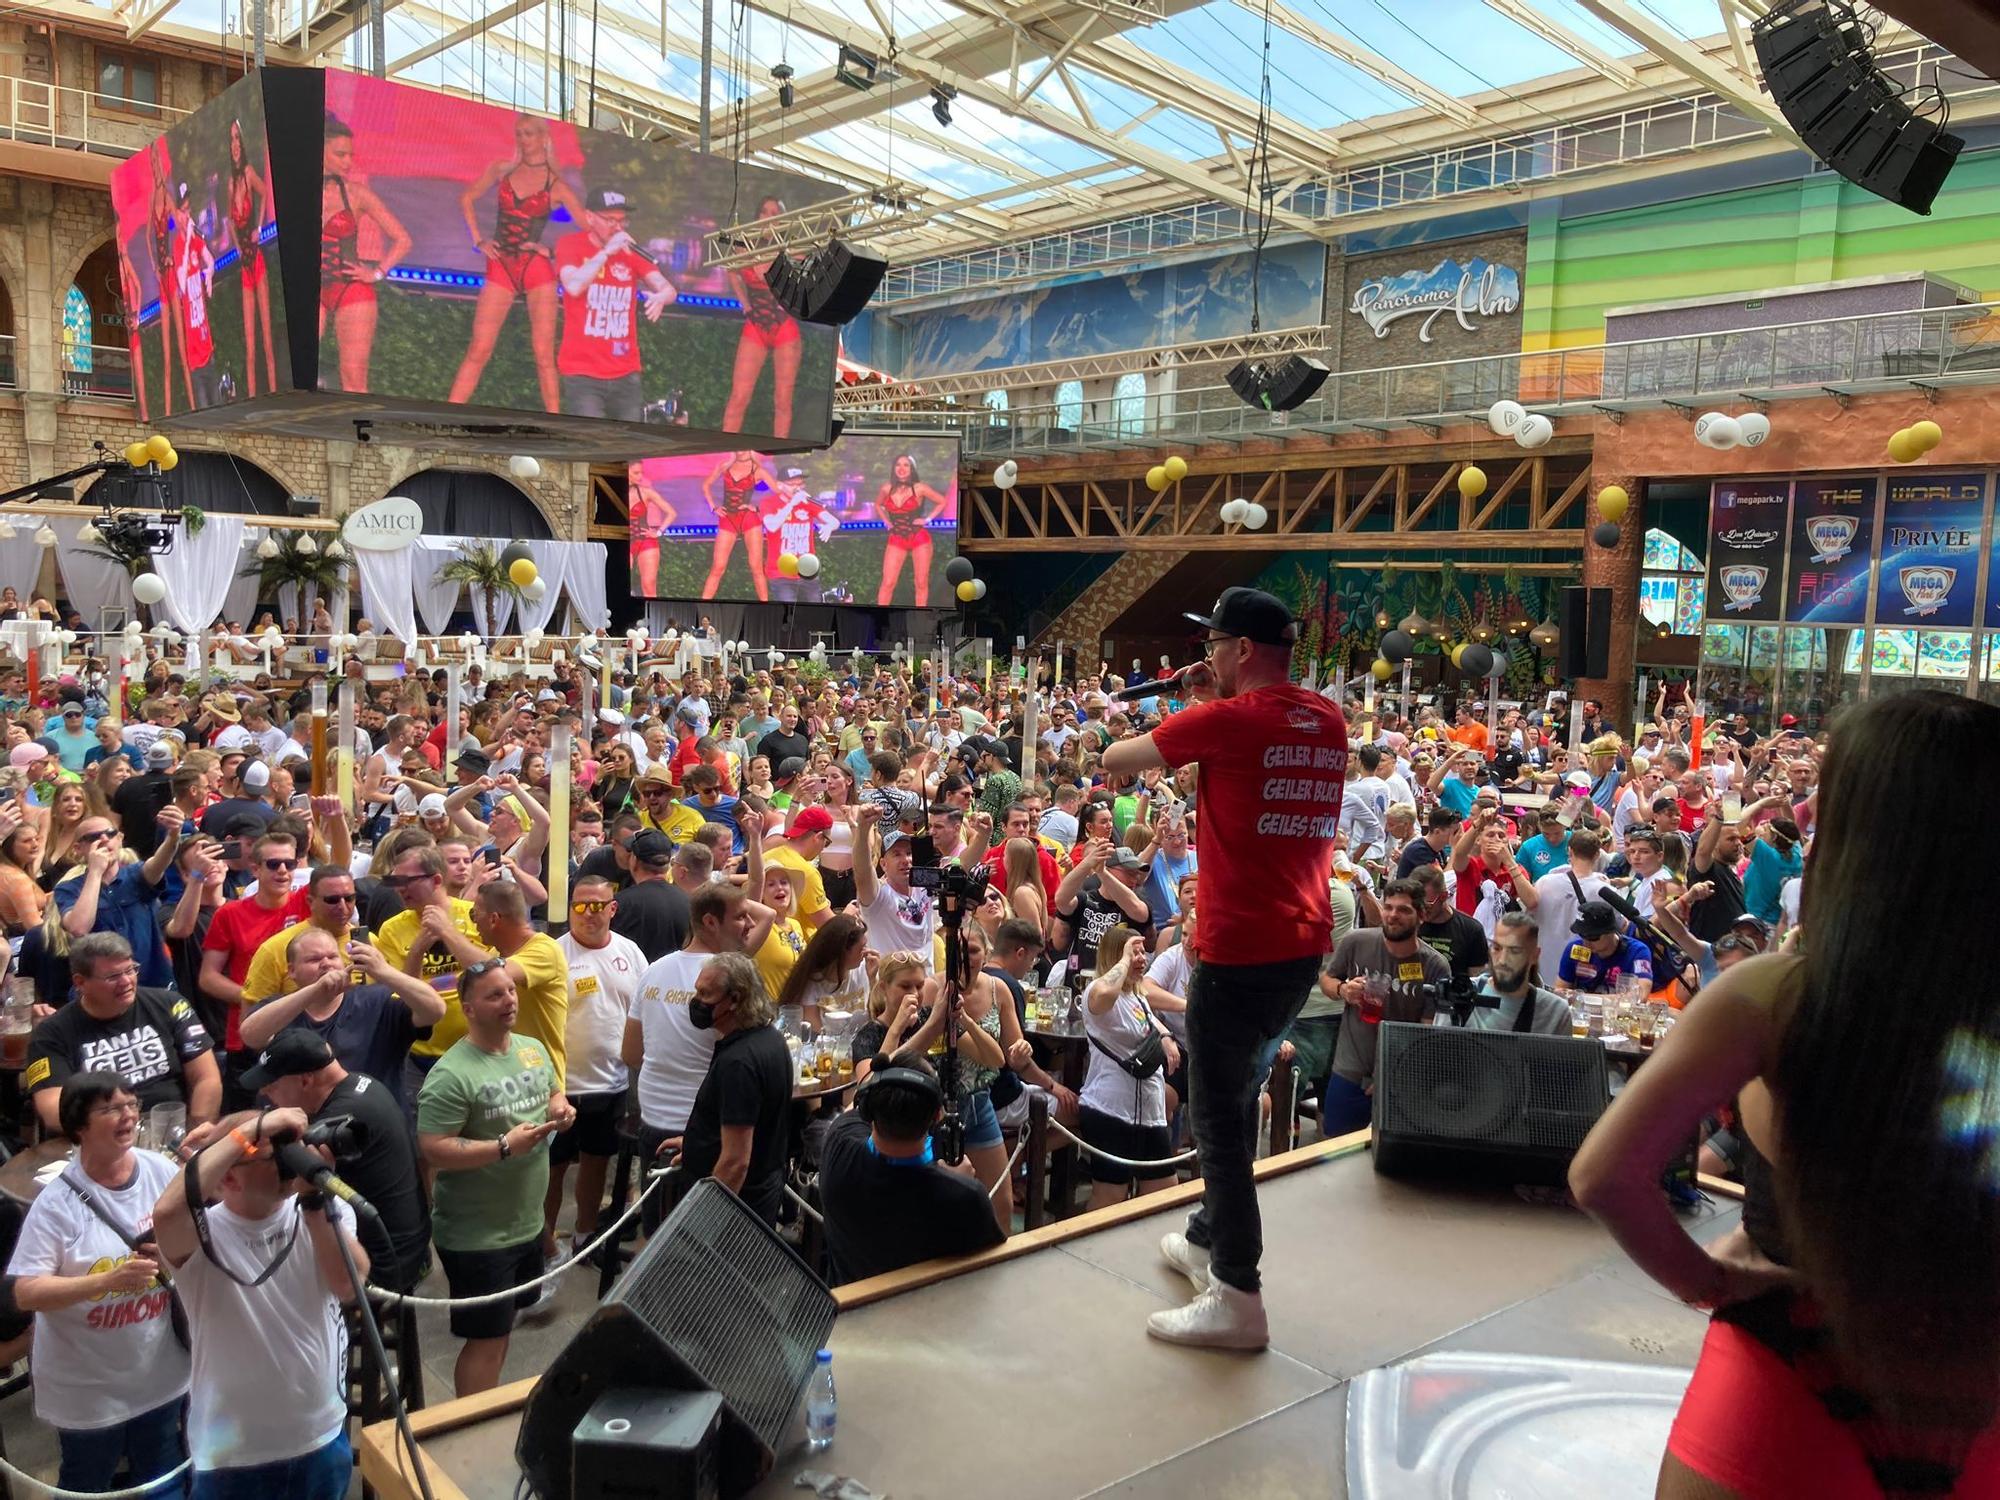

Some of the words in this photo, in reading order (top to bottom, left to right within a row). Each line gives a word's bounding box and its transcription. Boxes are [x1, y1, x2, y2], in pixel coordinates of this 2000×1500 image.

[1350, 283, 1451, 321] Panorama
[1419, 264, 1517, 342] Alm
[584, 309, 629, 339] LENA
[1737, 495, 1784, 506] megapark.tv
[1818, 489, 1863, 505] THE
[1892, 485, 1980, 502] WORLD
[356, 513, 416, 530] AMICI
[1816, 526, 1848, 538] MEGA
[1729, 575, 1758, 587] MEGA
[1909, 577, 1943, 589] MEGA
[1263, 745, 1312, 769] GEILER
[1262, 778, 1313, 801] GEILER
[1313, 781, 1341, 803] BLICK
[1257, 812, 1308, 838] GEILES
[644, 986, 659, 1000] MR.
[82, 1024, 159, 1058] TANJA
[86, 1290, 172, 1329] SIMON
